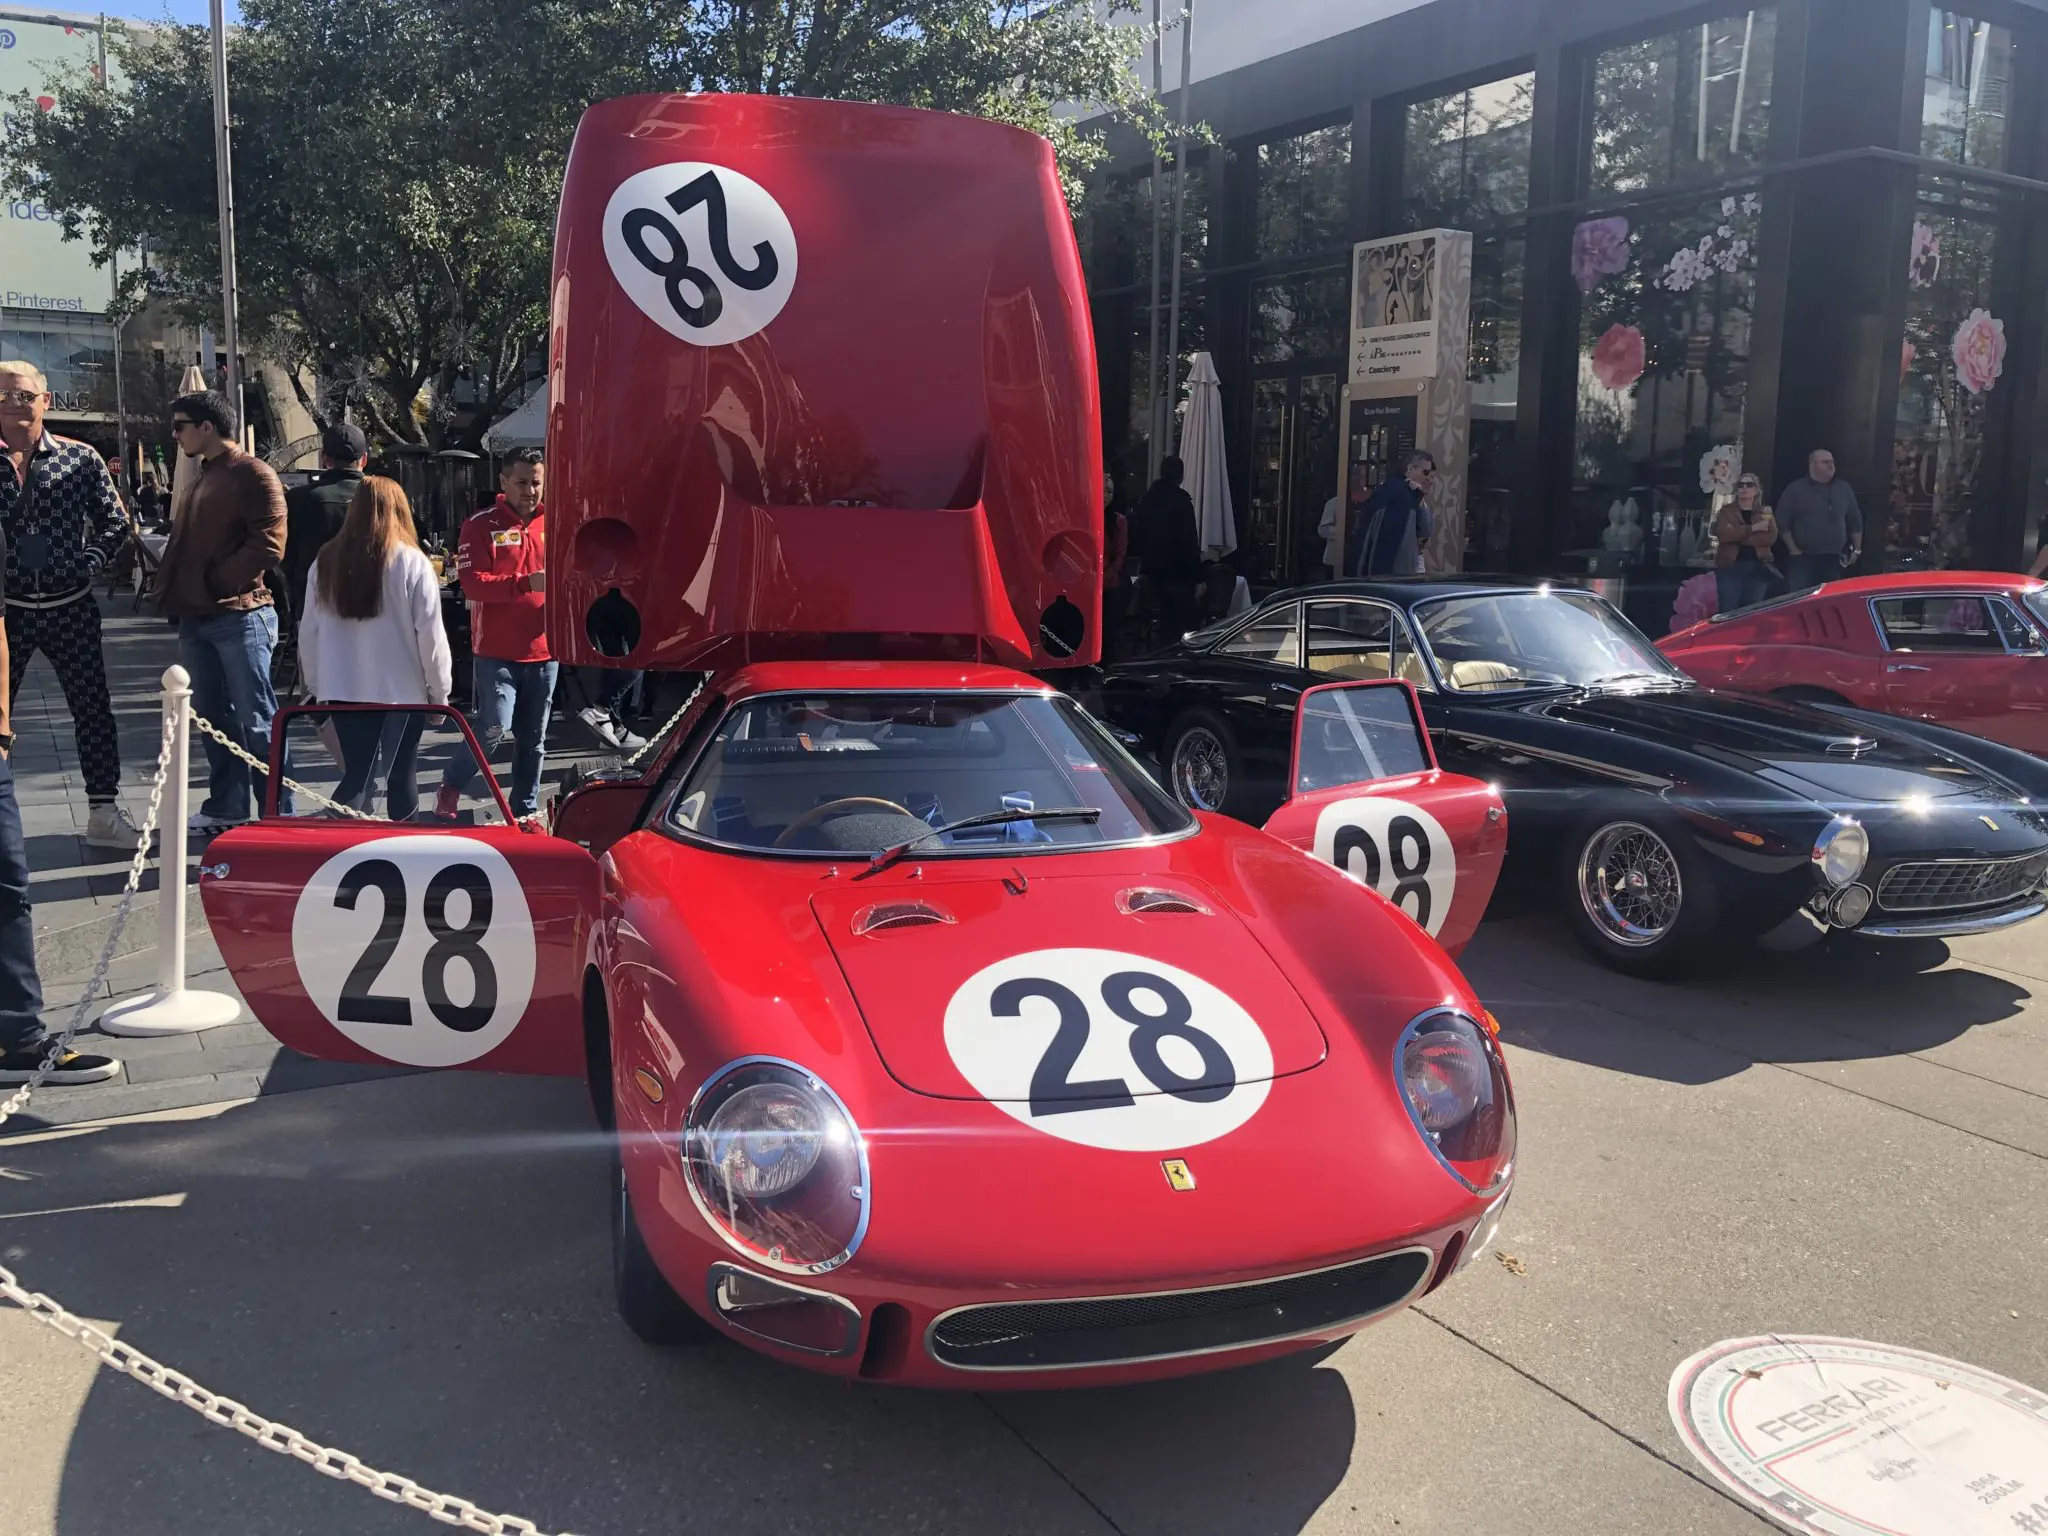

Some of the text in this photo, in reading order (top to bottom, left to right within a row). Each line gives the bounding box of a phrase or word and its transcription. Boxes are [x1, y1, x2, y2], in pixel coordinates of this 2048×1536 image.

[621, 169, 779, 329] 28
[7, 290, 87, 311] Pinterest.
[1368, 365, 1401, 374] Concierge
[109, 462, 122, 470] STO
[333, 858, 498, 1033] 28
[990, 970, 1236, 1117] 28
[1756, 1375, 1908, 1442] FERRARI
[1964, 1472, 2001, 1493] 1964
[1977, 1479, 2025, 1505] 250LM
[2009, 1495, 2048, 1536] #4
